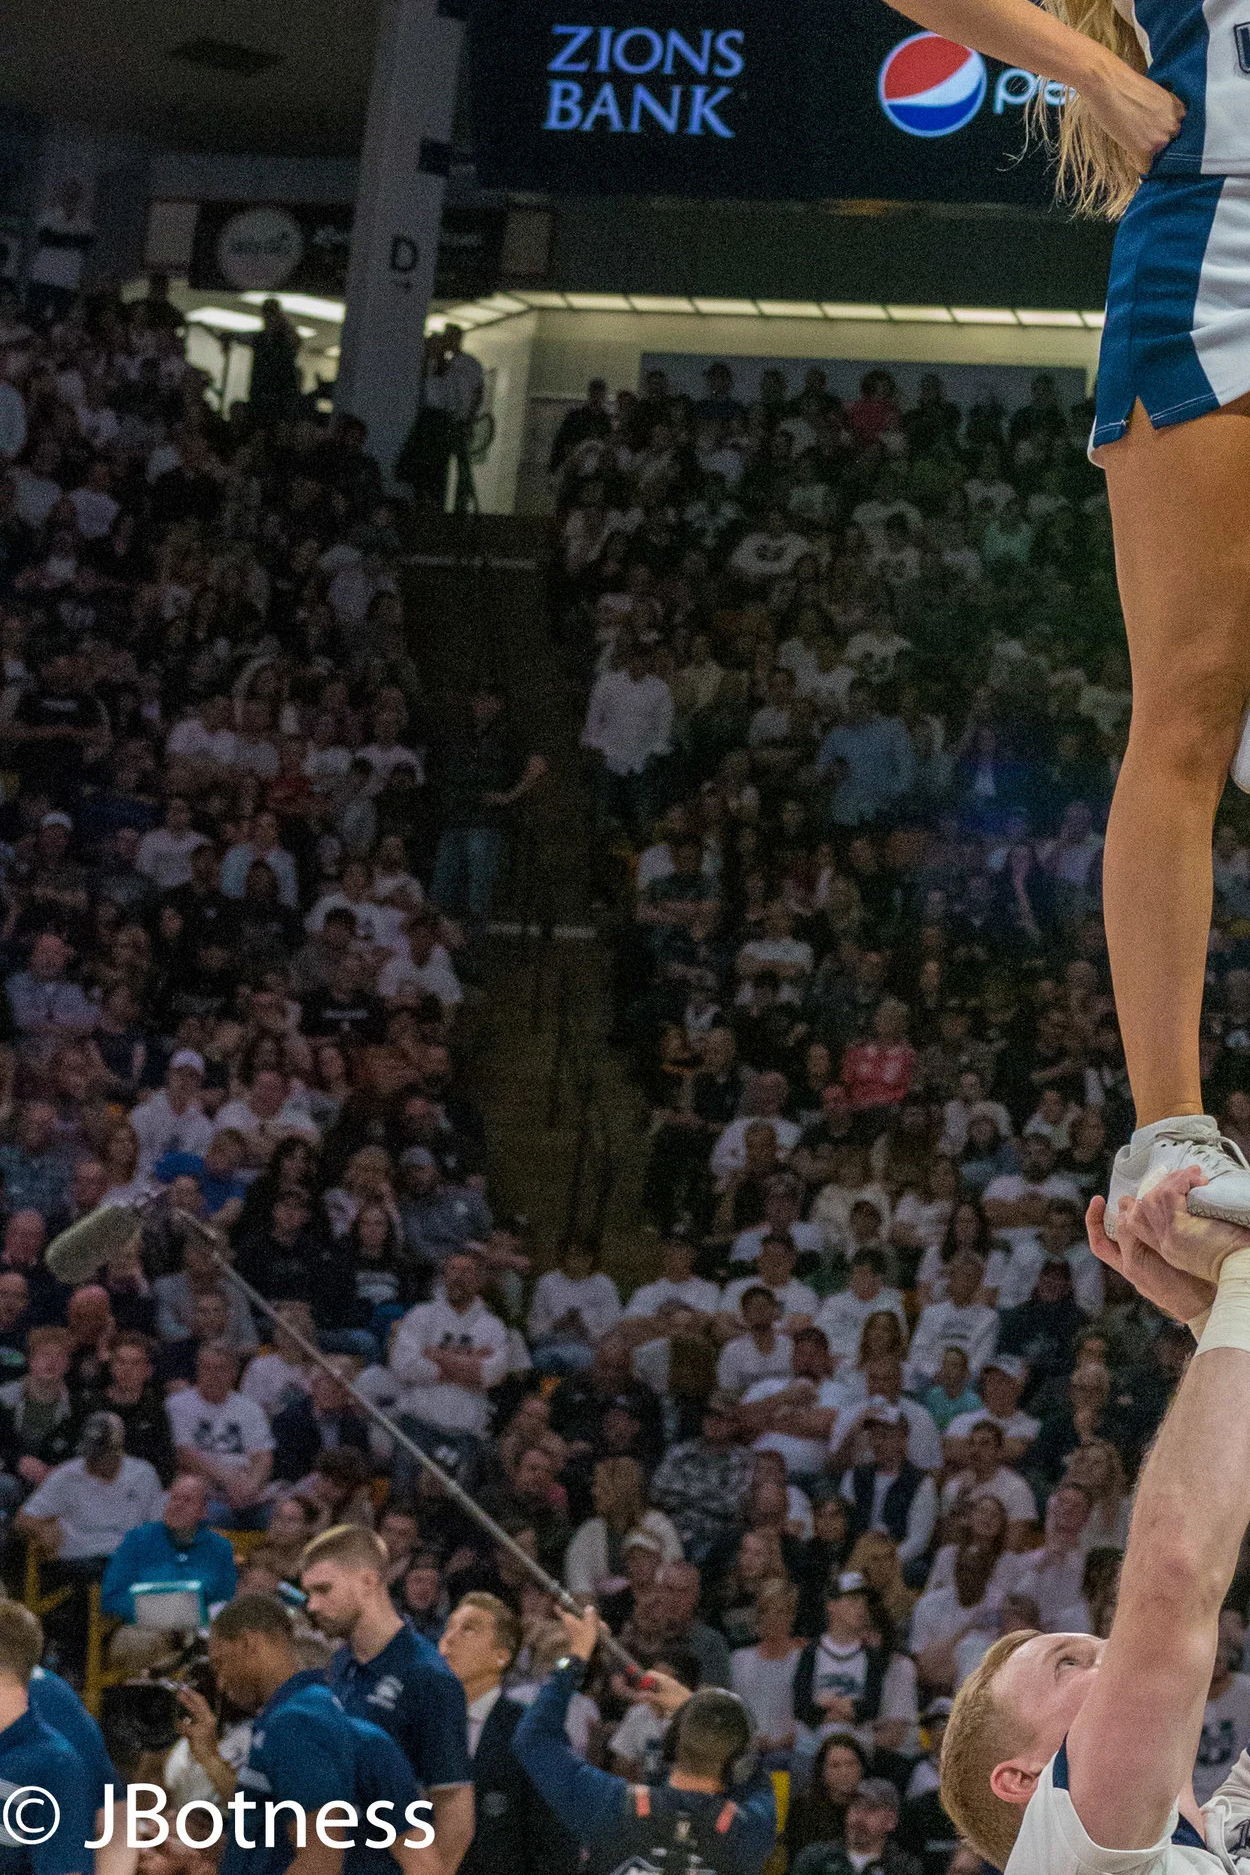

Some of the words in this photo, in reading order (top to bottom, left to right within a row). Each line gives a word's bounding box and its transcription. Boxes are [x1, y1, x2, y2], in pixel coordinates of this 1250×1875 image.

[548, 25, 744, 77] ZIONS
[543, 80, 736, 139] BANK
[994, 67, 1076, 115] pe
